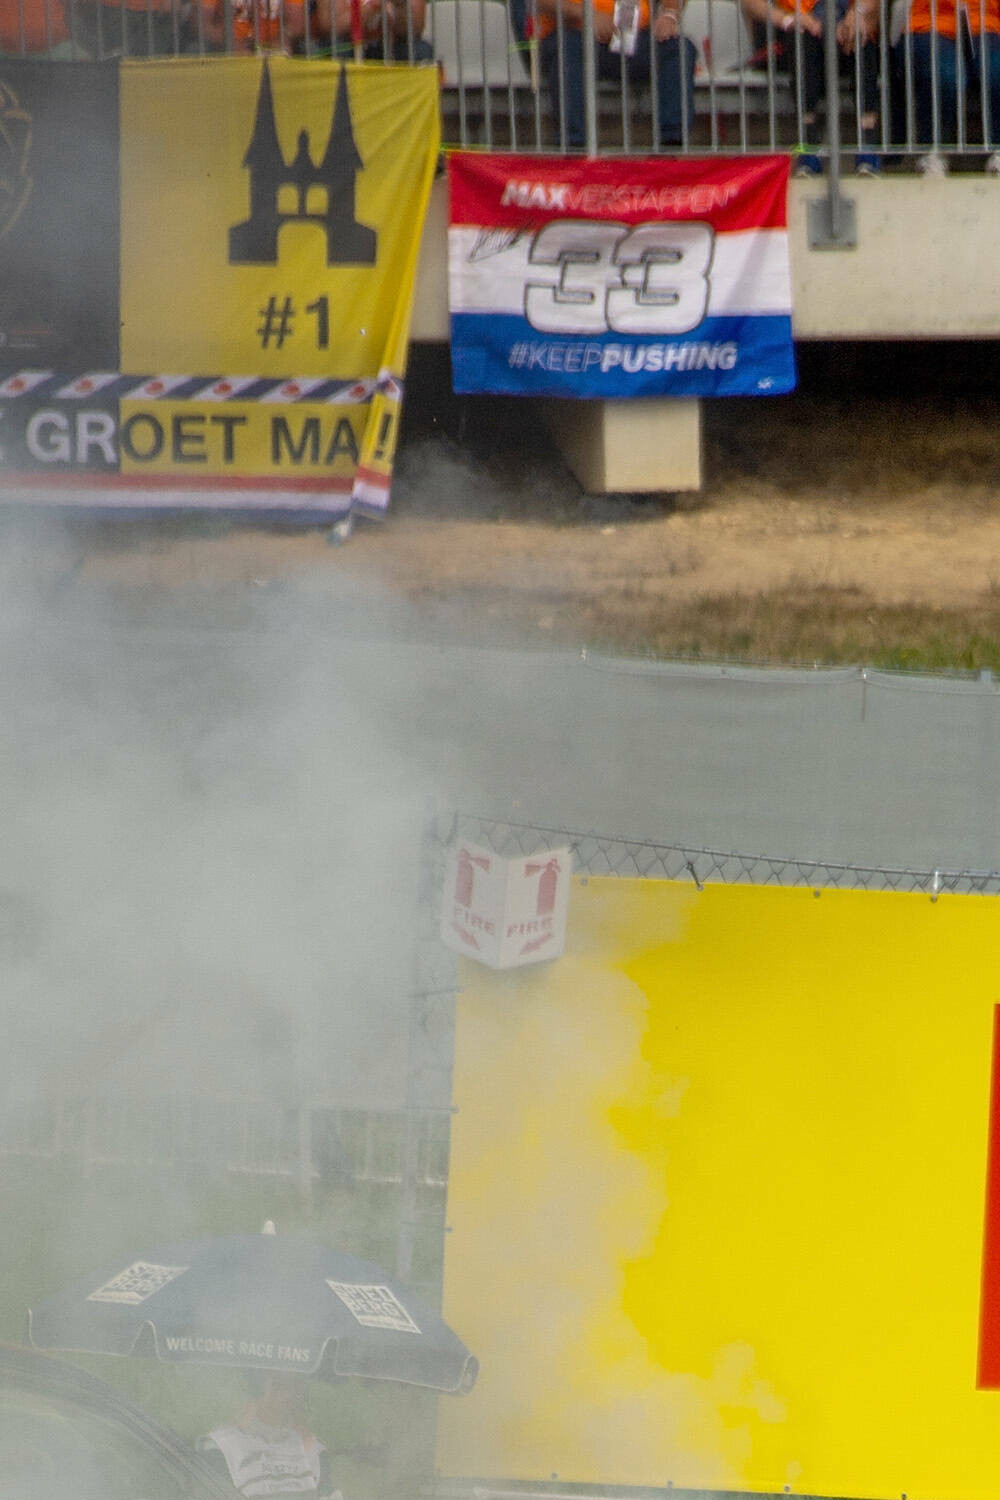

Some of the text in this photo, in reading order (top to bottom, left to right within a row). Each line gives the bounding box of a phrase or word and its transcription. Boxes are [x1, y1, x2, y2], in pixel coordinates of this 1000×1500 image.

[524, 219, 715, 336] 33
[257, 297, 330, 350] #1
[509, 342, 738, 373] #KEEPPUSHING
[25, 410, 246, 464] GROET
[166, 1337, 311, 1363] WELCOME RACE FANS
